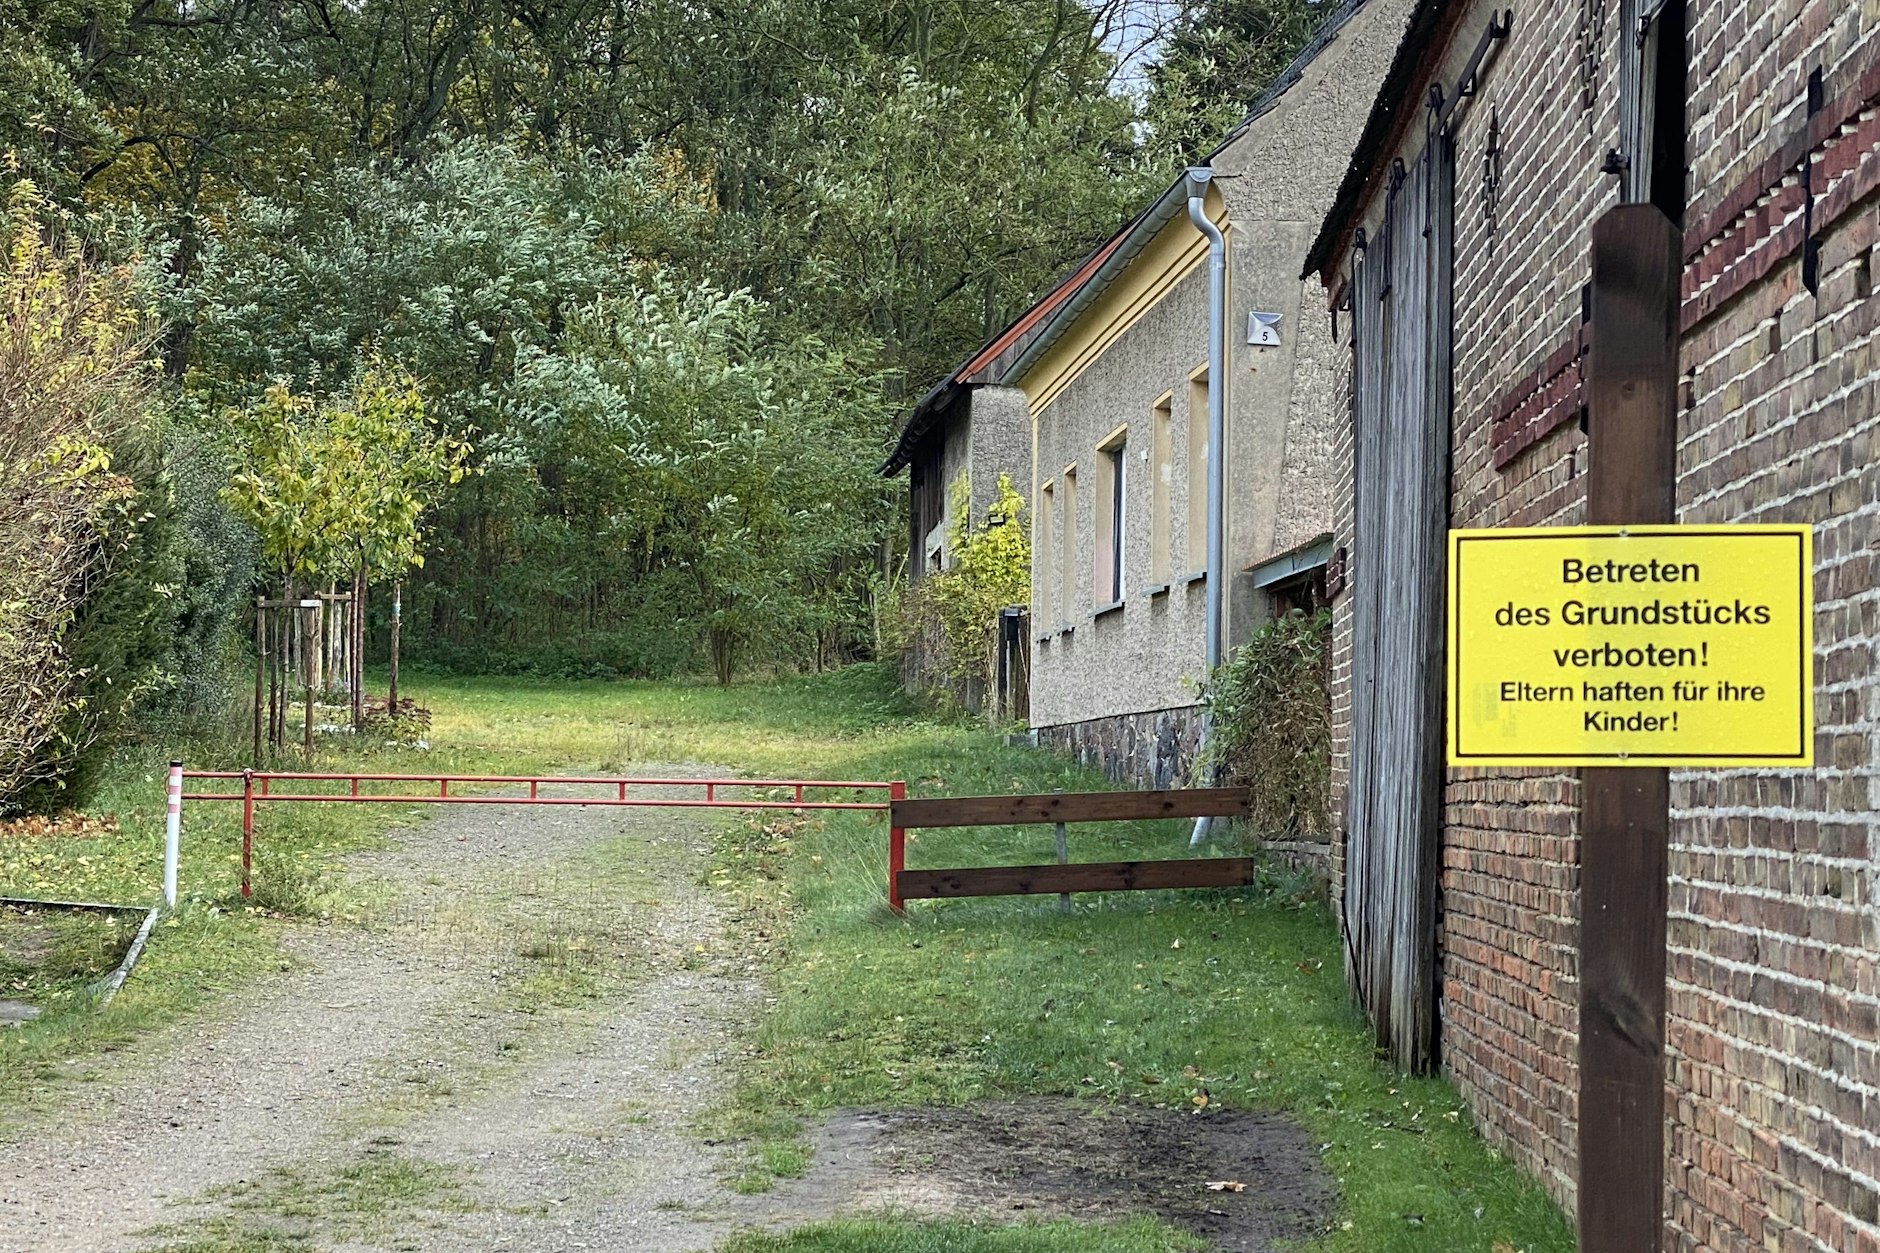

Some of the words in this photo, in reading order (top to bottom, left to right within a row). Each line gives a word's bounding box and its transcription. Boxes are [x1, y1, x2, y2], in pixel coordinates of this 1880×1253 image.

[1262, 331, 1268, 342] 5
[1564, 559, 1699, 583] Betreten
[1496, 602, 1550, 626] des
[1562, 600, 1770, 625] Grundstücks
[1554, 642, 1707, 667] verboten!
[1501, 682, 1573, 701] Eltern
[1584, 681, 1663, 701] haften
[1673, 681, 1708, 701] für
[1718, 681, 1764, 701] ihre
[1585, 711, 1677, 731] Kinder!
